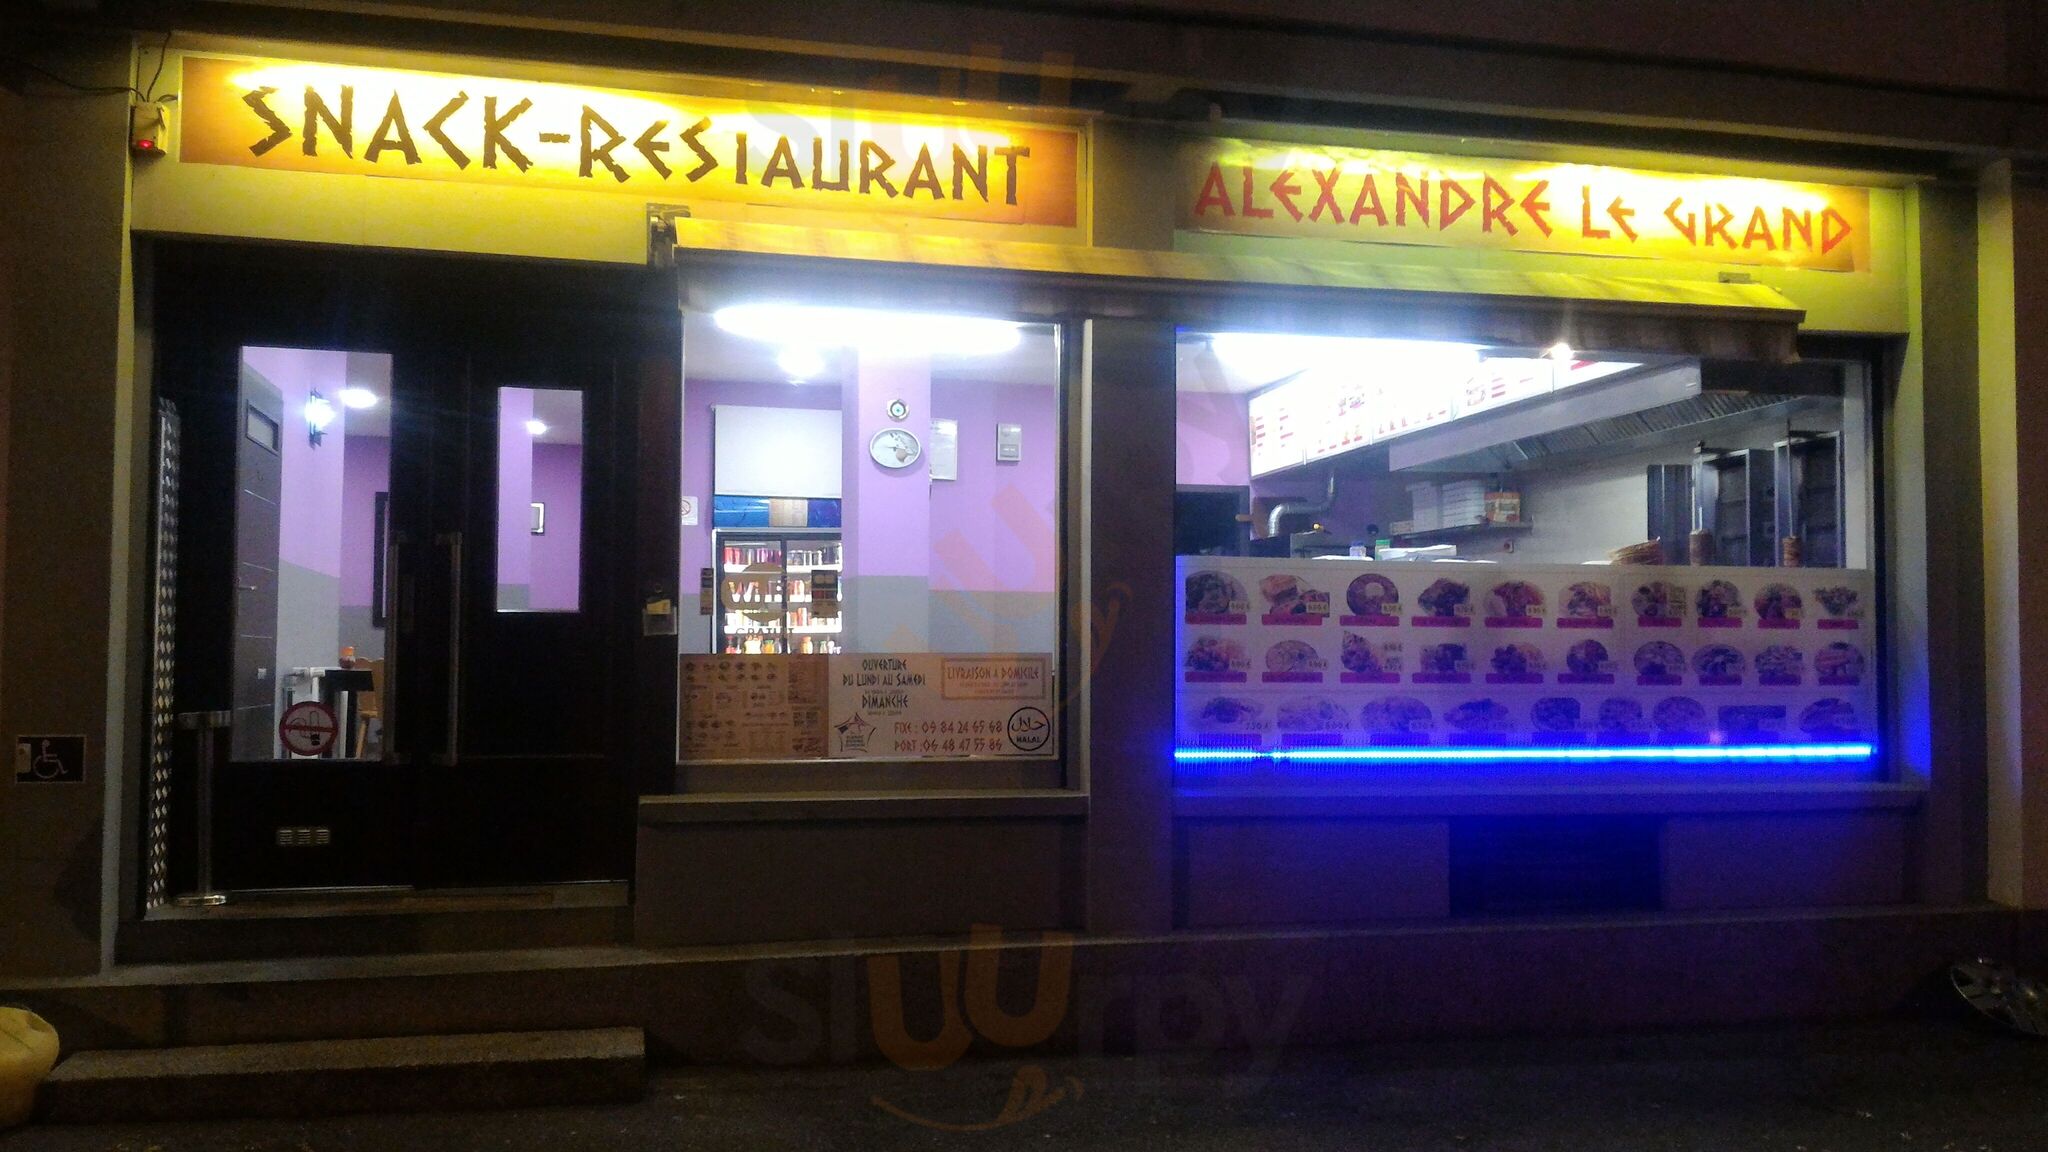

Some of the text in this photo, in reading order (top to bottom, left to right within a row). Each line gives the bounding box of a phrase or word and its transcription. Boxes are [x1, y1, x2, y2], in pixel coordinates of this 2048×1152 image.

[1194, 162, 1853, 256] ALEXANDRE LE GRAND
[862, 658, 908, 671] OUVERTURE
[861, 694, 908, 709] DIMANCHE
[1016, 736, 1042, 744] HALAL
